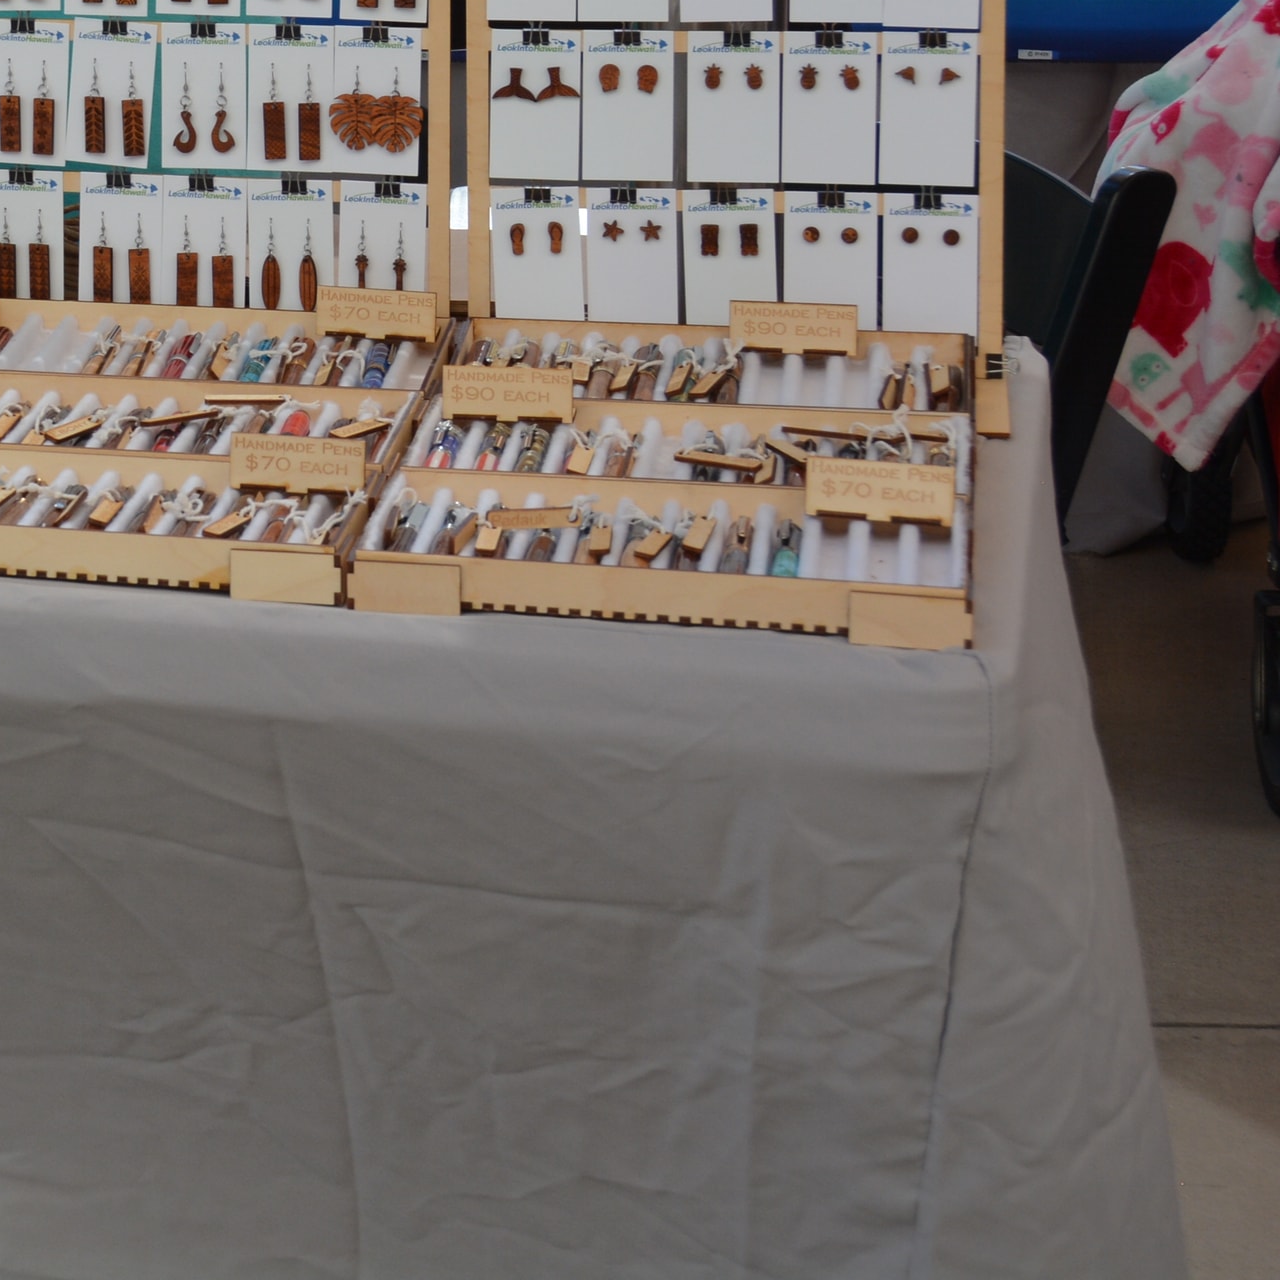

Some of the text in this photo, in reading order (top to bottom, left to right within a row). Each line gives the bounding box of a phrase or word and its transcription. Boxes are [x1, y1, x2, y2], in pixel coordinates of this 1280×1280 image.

[330, 306, 421, 324] $70 EACH
[744, 320, 841, 338] $90 EACH
[245, 453, 348, 477] $70 EACH
[821, 478, 935, 505] $70 EACH
